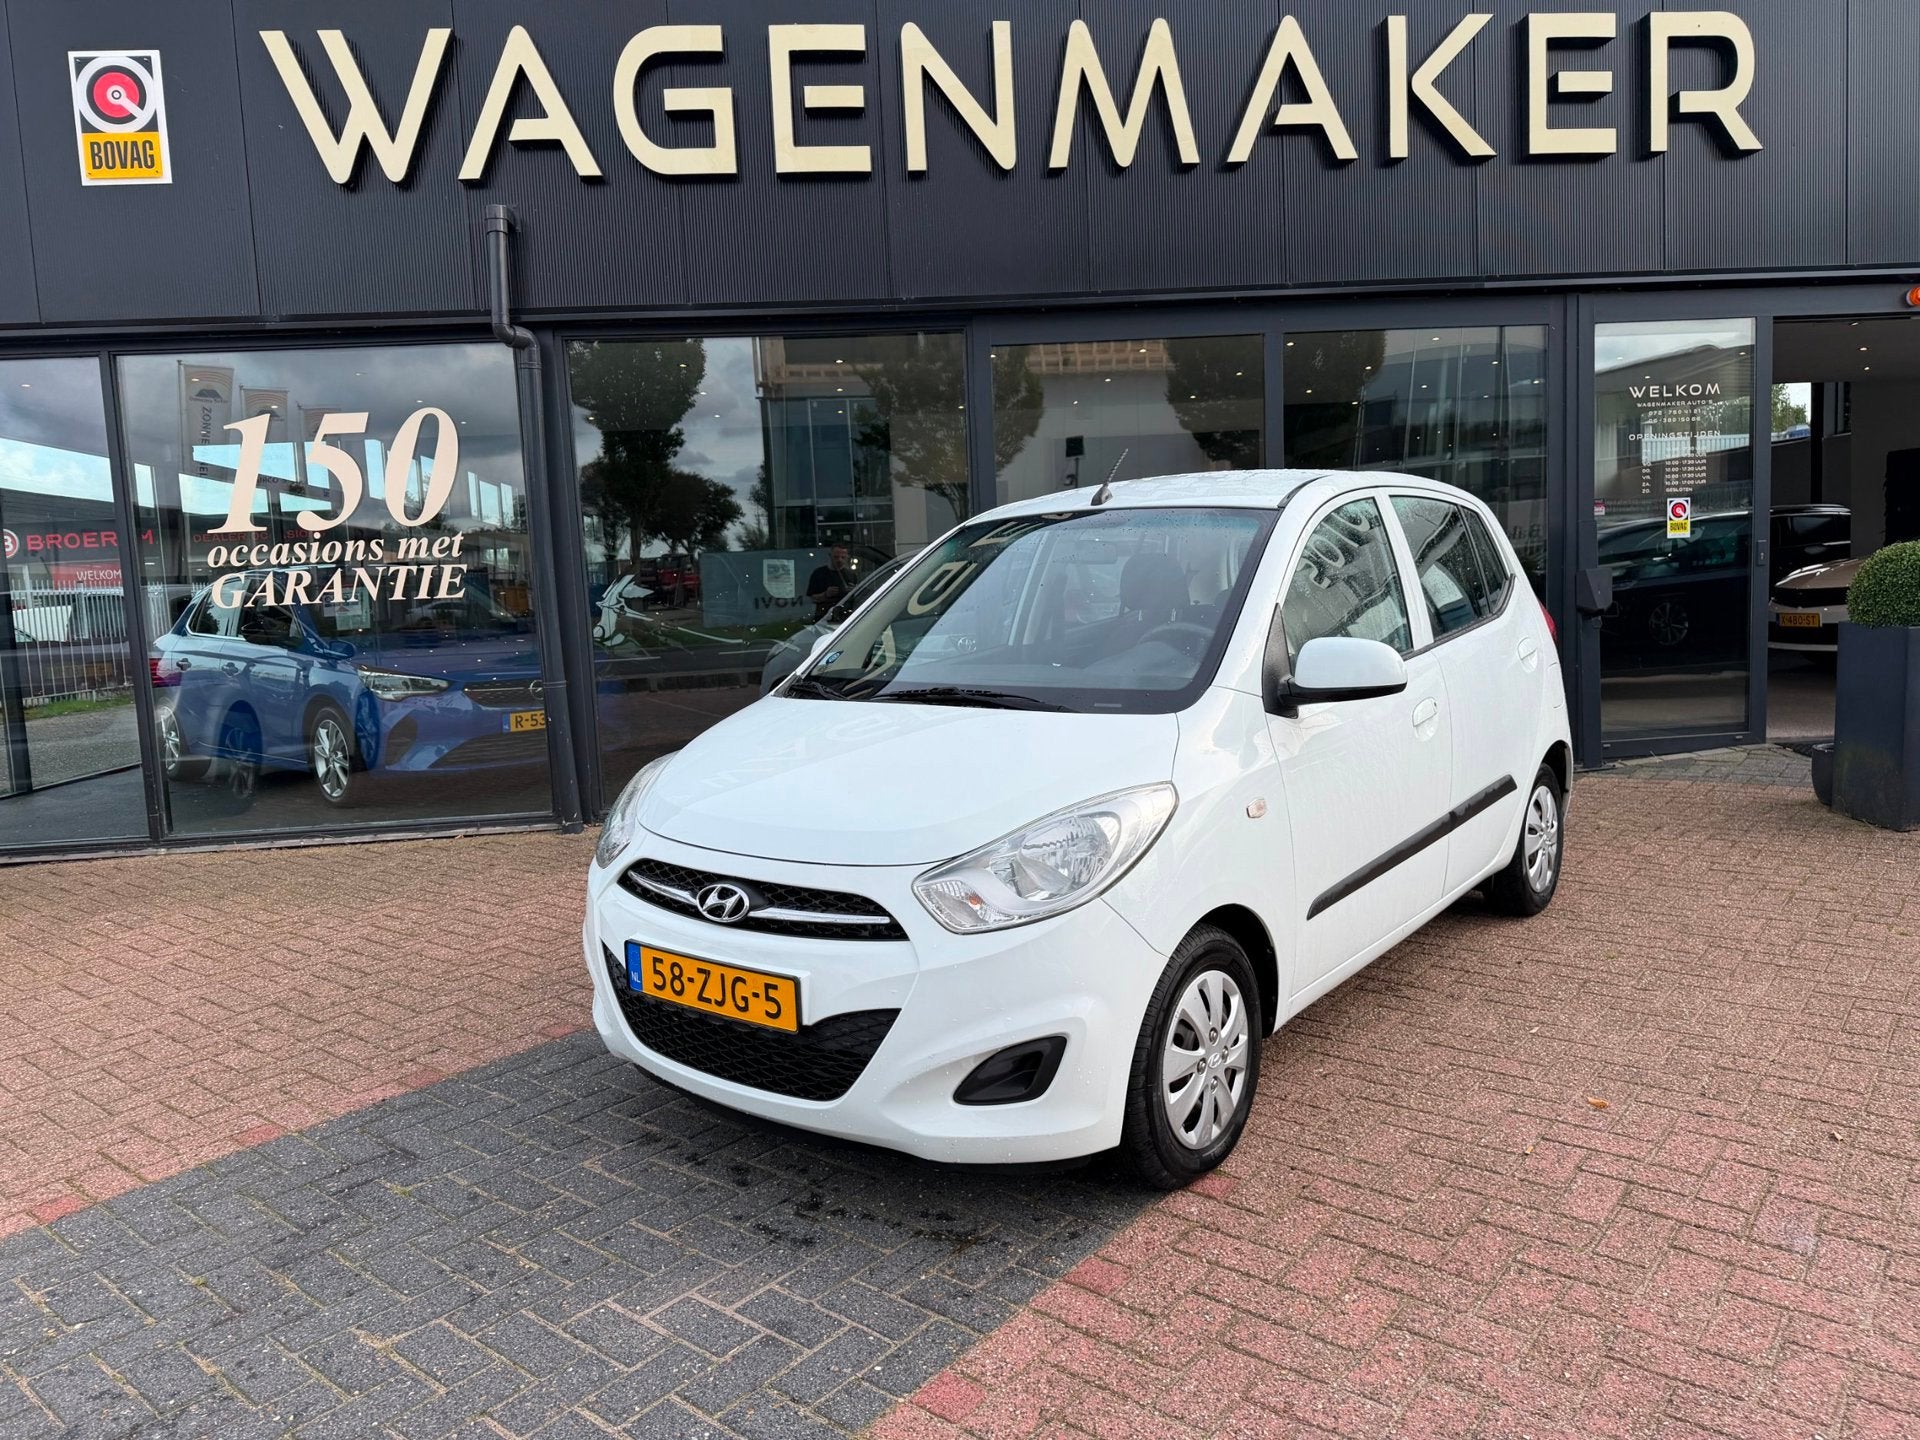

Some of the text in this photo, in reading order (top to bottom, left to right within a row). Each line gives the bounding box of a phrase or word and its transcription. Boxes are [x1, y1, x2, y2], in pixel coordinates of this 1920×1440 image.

[259, 11, 1763, 184] WAGENMAKER
[90, 140, 155, 170] BOVAG
[1629, 383, 1720, 398] WELKOM
[1636, 400, 1686, 408] WAGENMAKER
[1629, 430, 1720, 441] OPENINGSTIJDEN
[207, 407, 459, 534] 150
[207, 530, 465, 568] occasions met
[76, 569, 122, 581] WELKOM
[212, 564, 468, 609] GARANTIE
[631, 970, 641, 983] NL
[652, 956, 782, 1020] 58-ZJG-5
